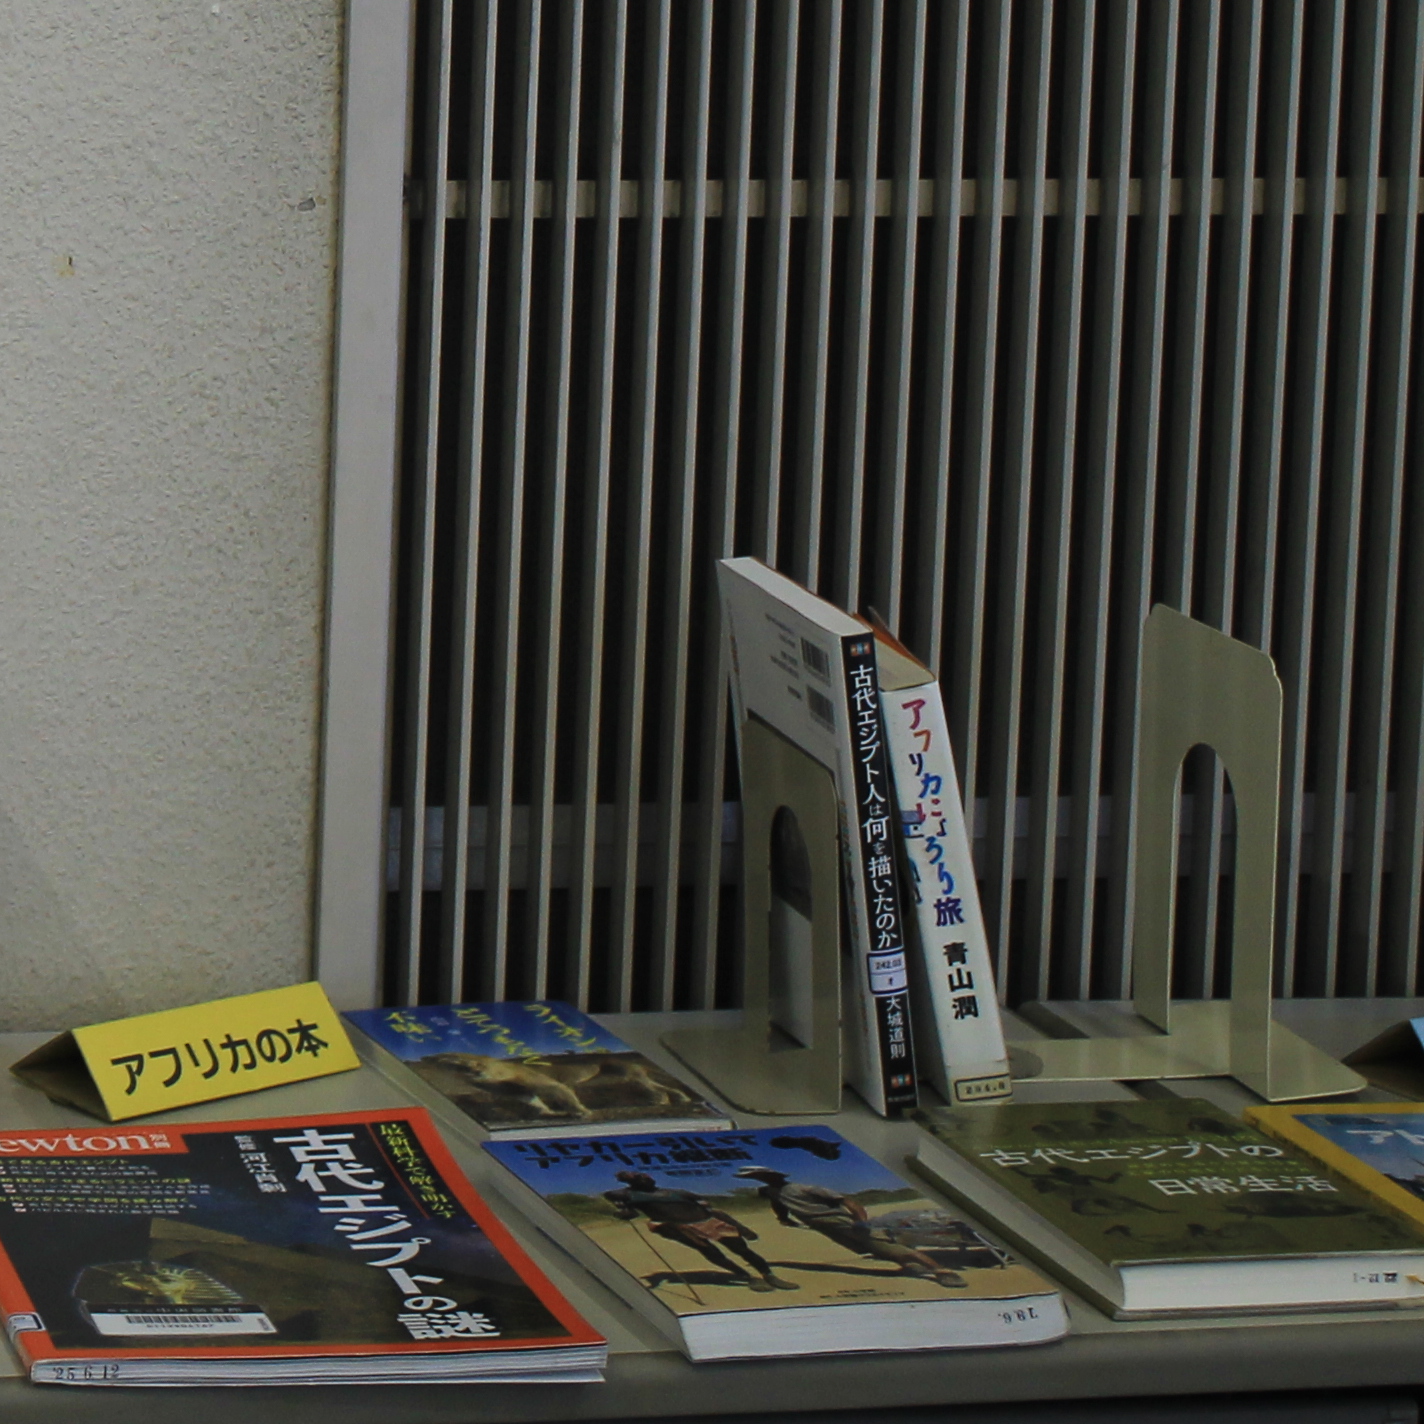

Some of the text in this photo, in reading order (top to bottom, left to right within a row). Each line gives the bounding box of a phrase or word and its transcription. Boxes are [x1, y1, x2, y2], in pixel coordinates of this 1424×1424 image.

[850, 665, 899, 949] 古代エジプト人は何を描いたのか
[943, 942, 979, 1019] 青山潤
[111, 1019, 329, 1095] アフリカの本
[980, 1142, 1285, 1167] 古代エジプトの
[1148, 1176, 1340, 1197] 日常生活
[273, 1129, 501, 1339] 古代エジプトの謎
